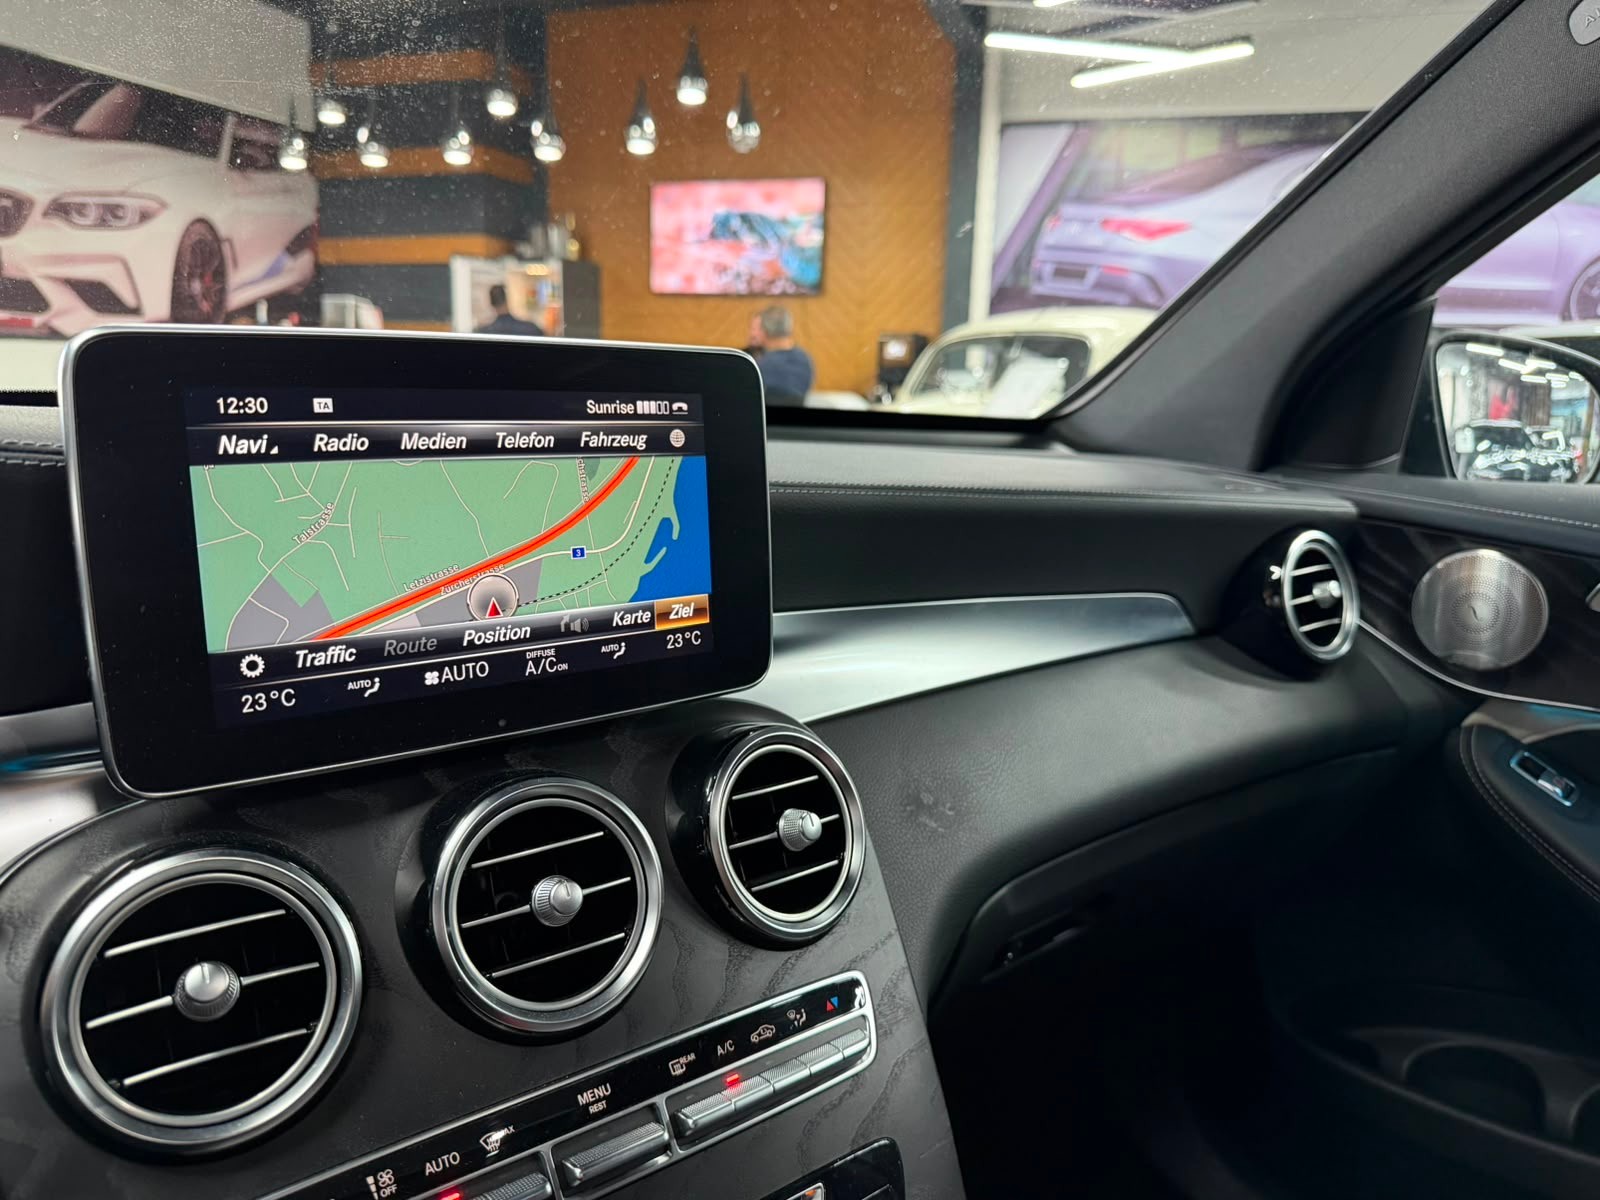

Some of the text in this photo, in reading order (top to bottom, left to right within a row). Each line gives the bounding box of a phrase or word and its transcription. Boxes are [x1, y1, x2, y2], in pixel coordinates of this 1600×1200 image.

[216, 397, 269, 415] 12:30
[586, 400, 635, 414] Sunrise
[218, 431, 648, 455] Navi Radio Medien Telefon Fahrzeug
[292, 502, 334, 544] Talstrasse
[403, 564, 459, 592] Letzistrasse
[295, 602, 694, 668] Traffic Route Position Karte Ziel
[666, 631, 702, 650] 23°C
[526, 648, 556, 659] DIFFUSE
[601, 644, 619, 653] AUTO
[441, 661, 490, 683] AUTO
[525, 657, 569, 676] A/C ON
[347, 679, 372, 690] AUTO
[240, 688, 296, 714] 23°C
[716, 1039, 735, 1057] A/C
[679, 1052, 696, 1065] REAR
[577, 1083, 612, 1106] MENU
[588, 1100, 607, 1115] REST
[424, 1151, 461, 1176] AUTO
[380, 1184, 398, 1198] OFF
